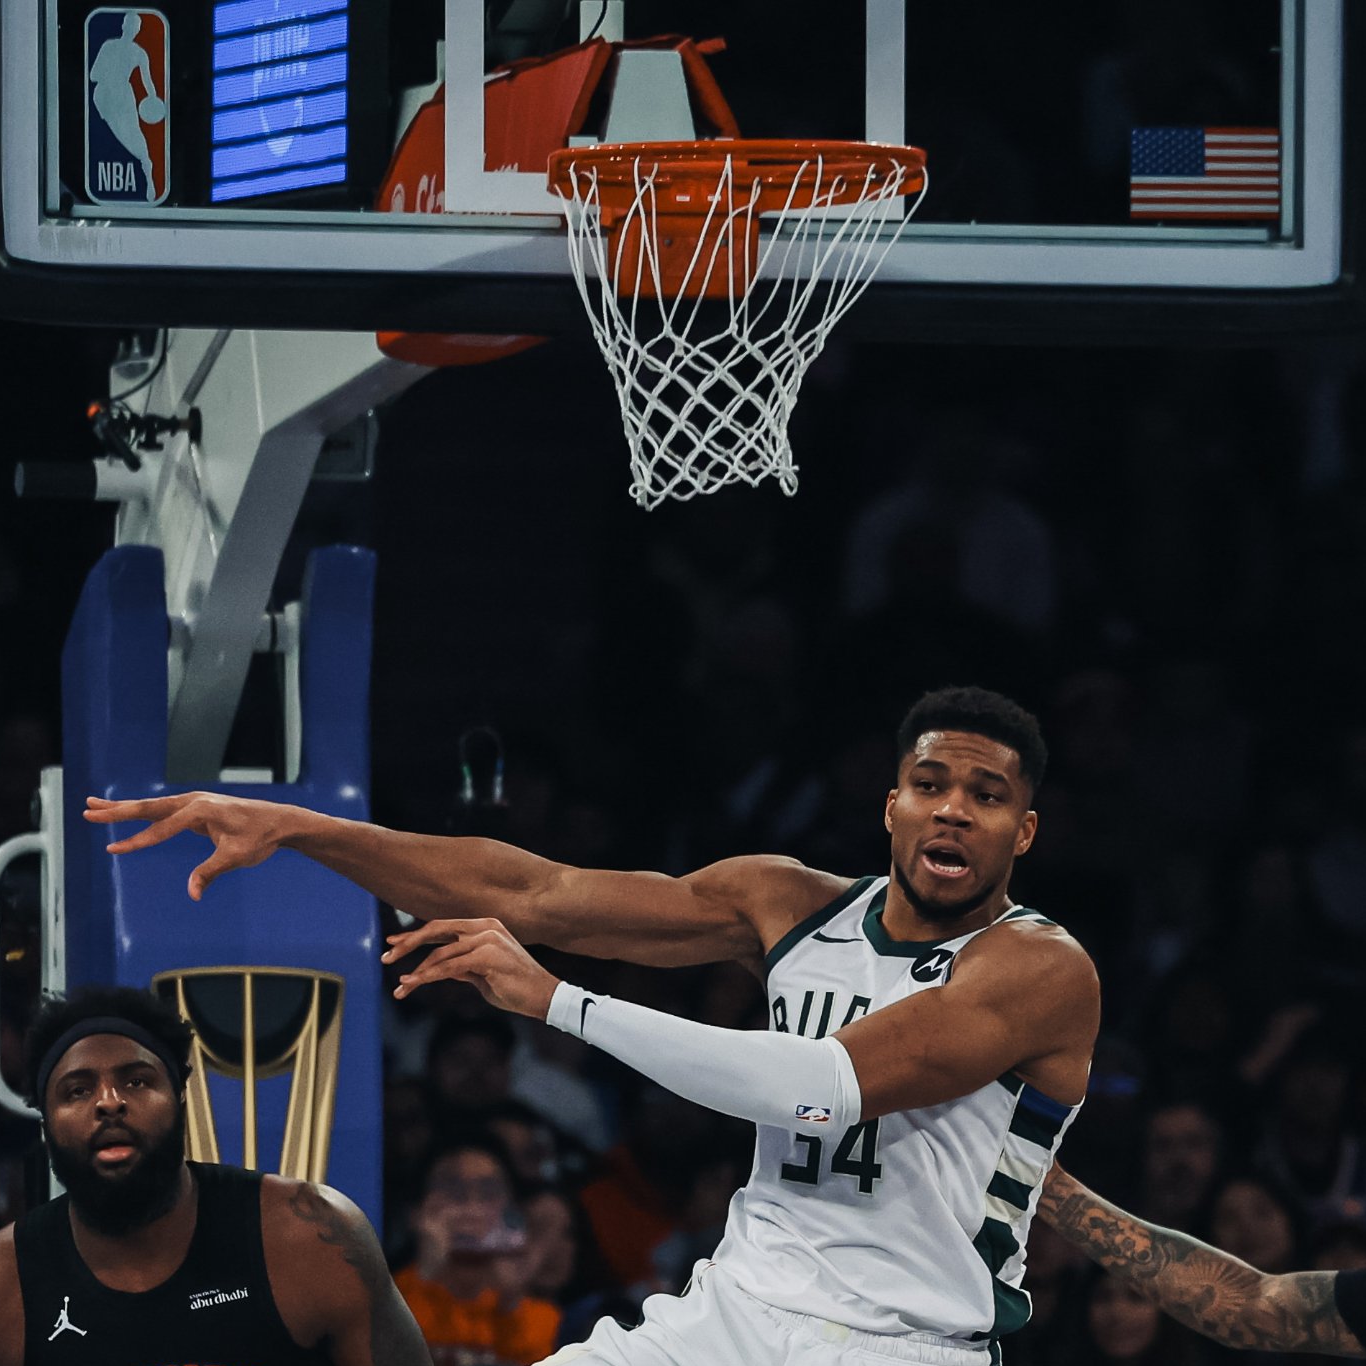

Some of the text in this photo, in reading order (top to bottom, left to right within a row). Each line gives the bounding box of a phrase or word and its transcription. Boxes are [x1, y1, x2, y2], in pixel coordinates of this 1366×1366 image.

[97, 161, 137, 193] NBA
[190, 1287, 250, 1310] abu dhabi
